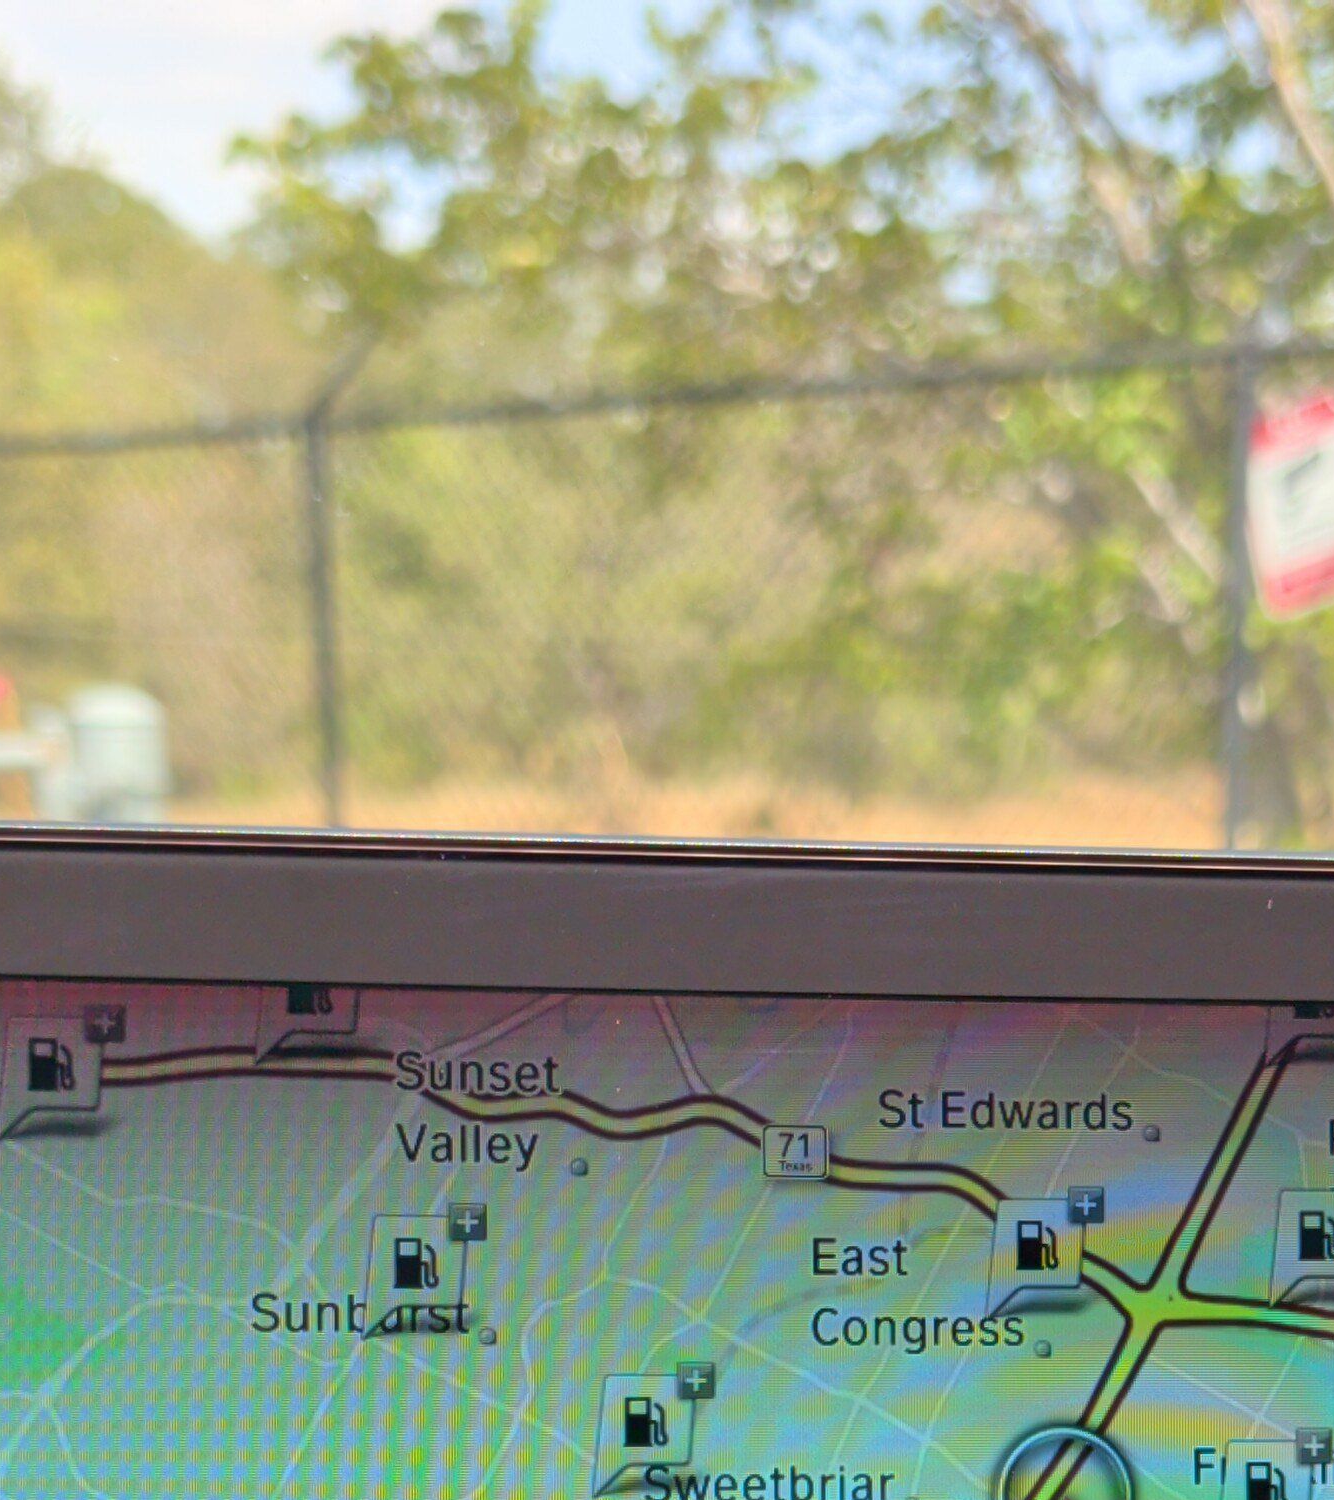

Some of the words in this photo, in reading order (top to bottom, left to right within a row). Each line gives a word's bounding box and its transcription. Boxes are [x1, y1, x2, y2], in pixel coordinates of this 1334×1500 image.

[394, 1051, 562, 1093] Sunset
[878, 1090, 925, 1130] St
[940, 1092, 1134, 1132] Edwards
[394, 1125, 539, 1173] Valley
[778, 1132, 809, 1158] 71
[811, 1237, 909, 1277] East
[811, 1308, 1025, 1354] Congress
